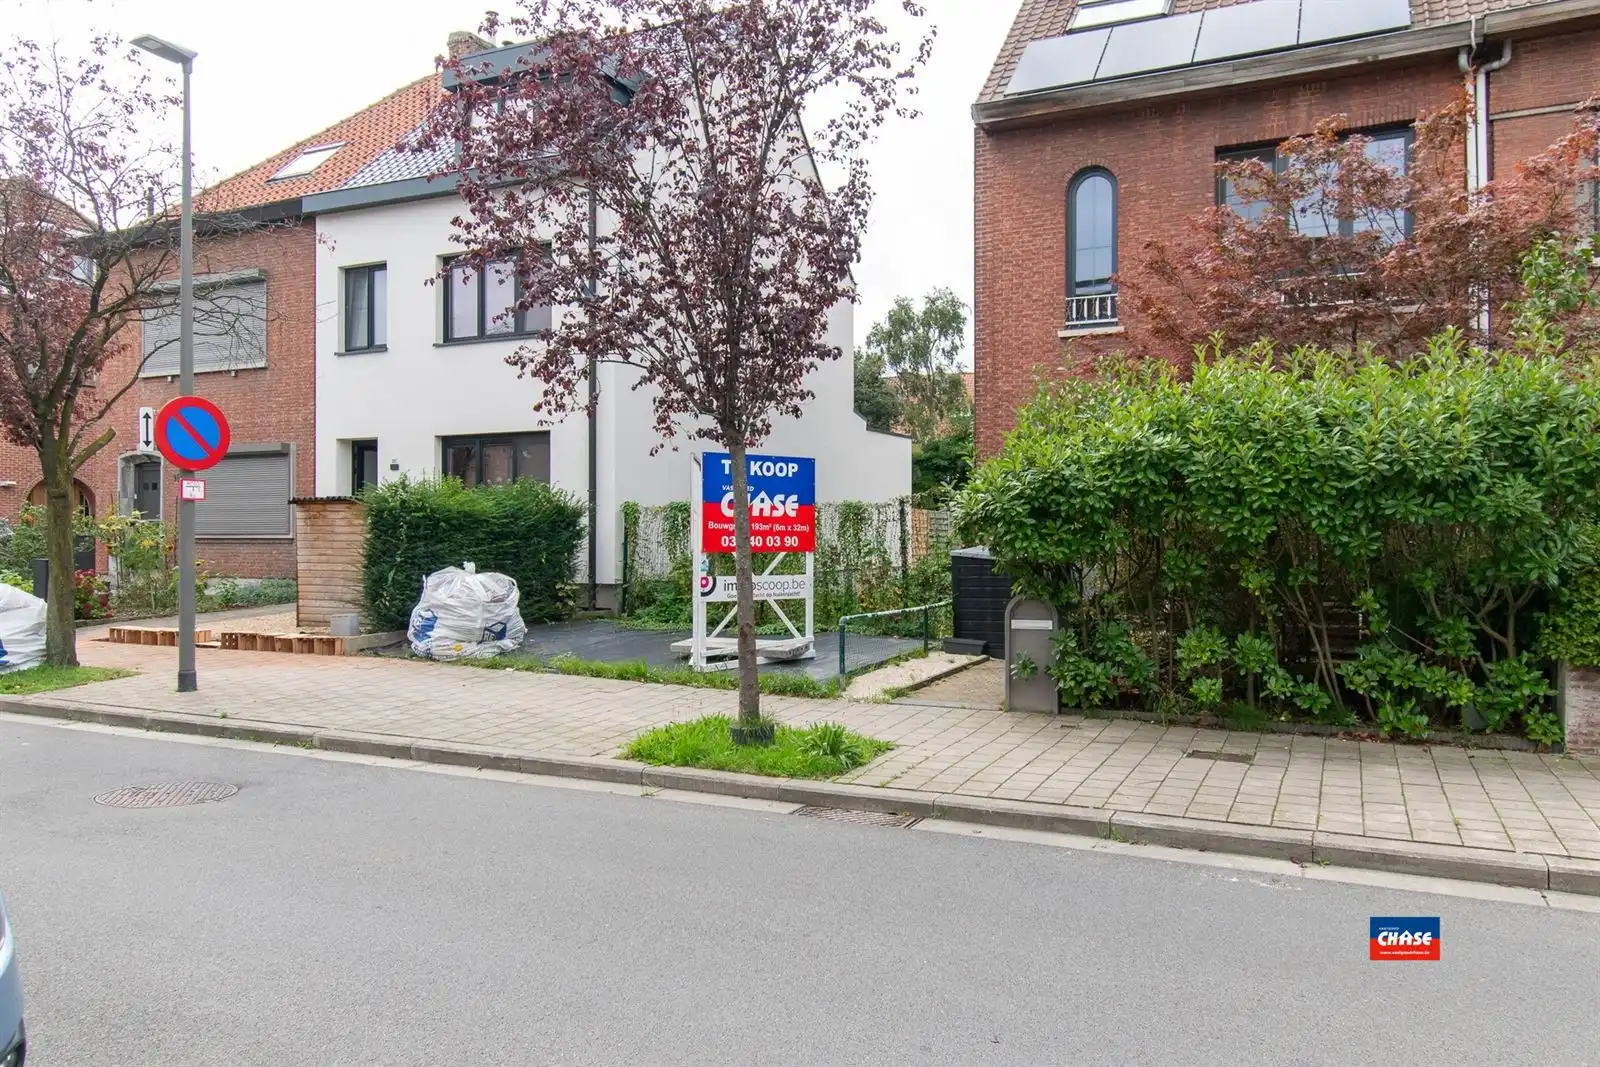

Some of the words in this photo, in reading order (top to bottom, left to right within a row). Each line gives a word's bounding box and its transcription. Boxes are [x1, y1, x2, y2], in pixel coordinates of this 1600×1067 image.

[750, 461, 799, 477] KOOP
[721, 491, 799, 517] CASE
[708, 521, 736, 532] Bouwgr
[793, 524, 810, 533] 32m)
[721, 536, 737, 547] 03
[749, 536, 763, 547] 40
[766, 536, 781, 547] 03
[784, 536, 799, 547] 90
[723, 579, 806, 591] imoscoop.be
